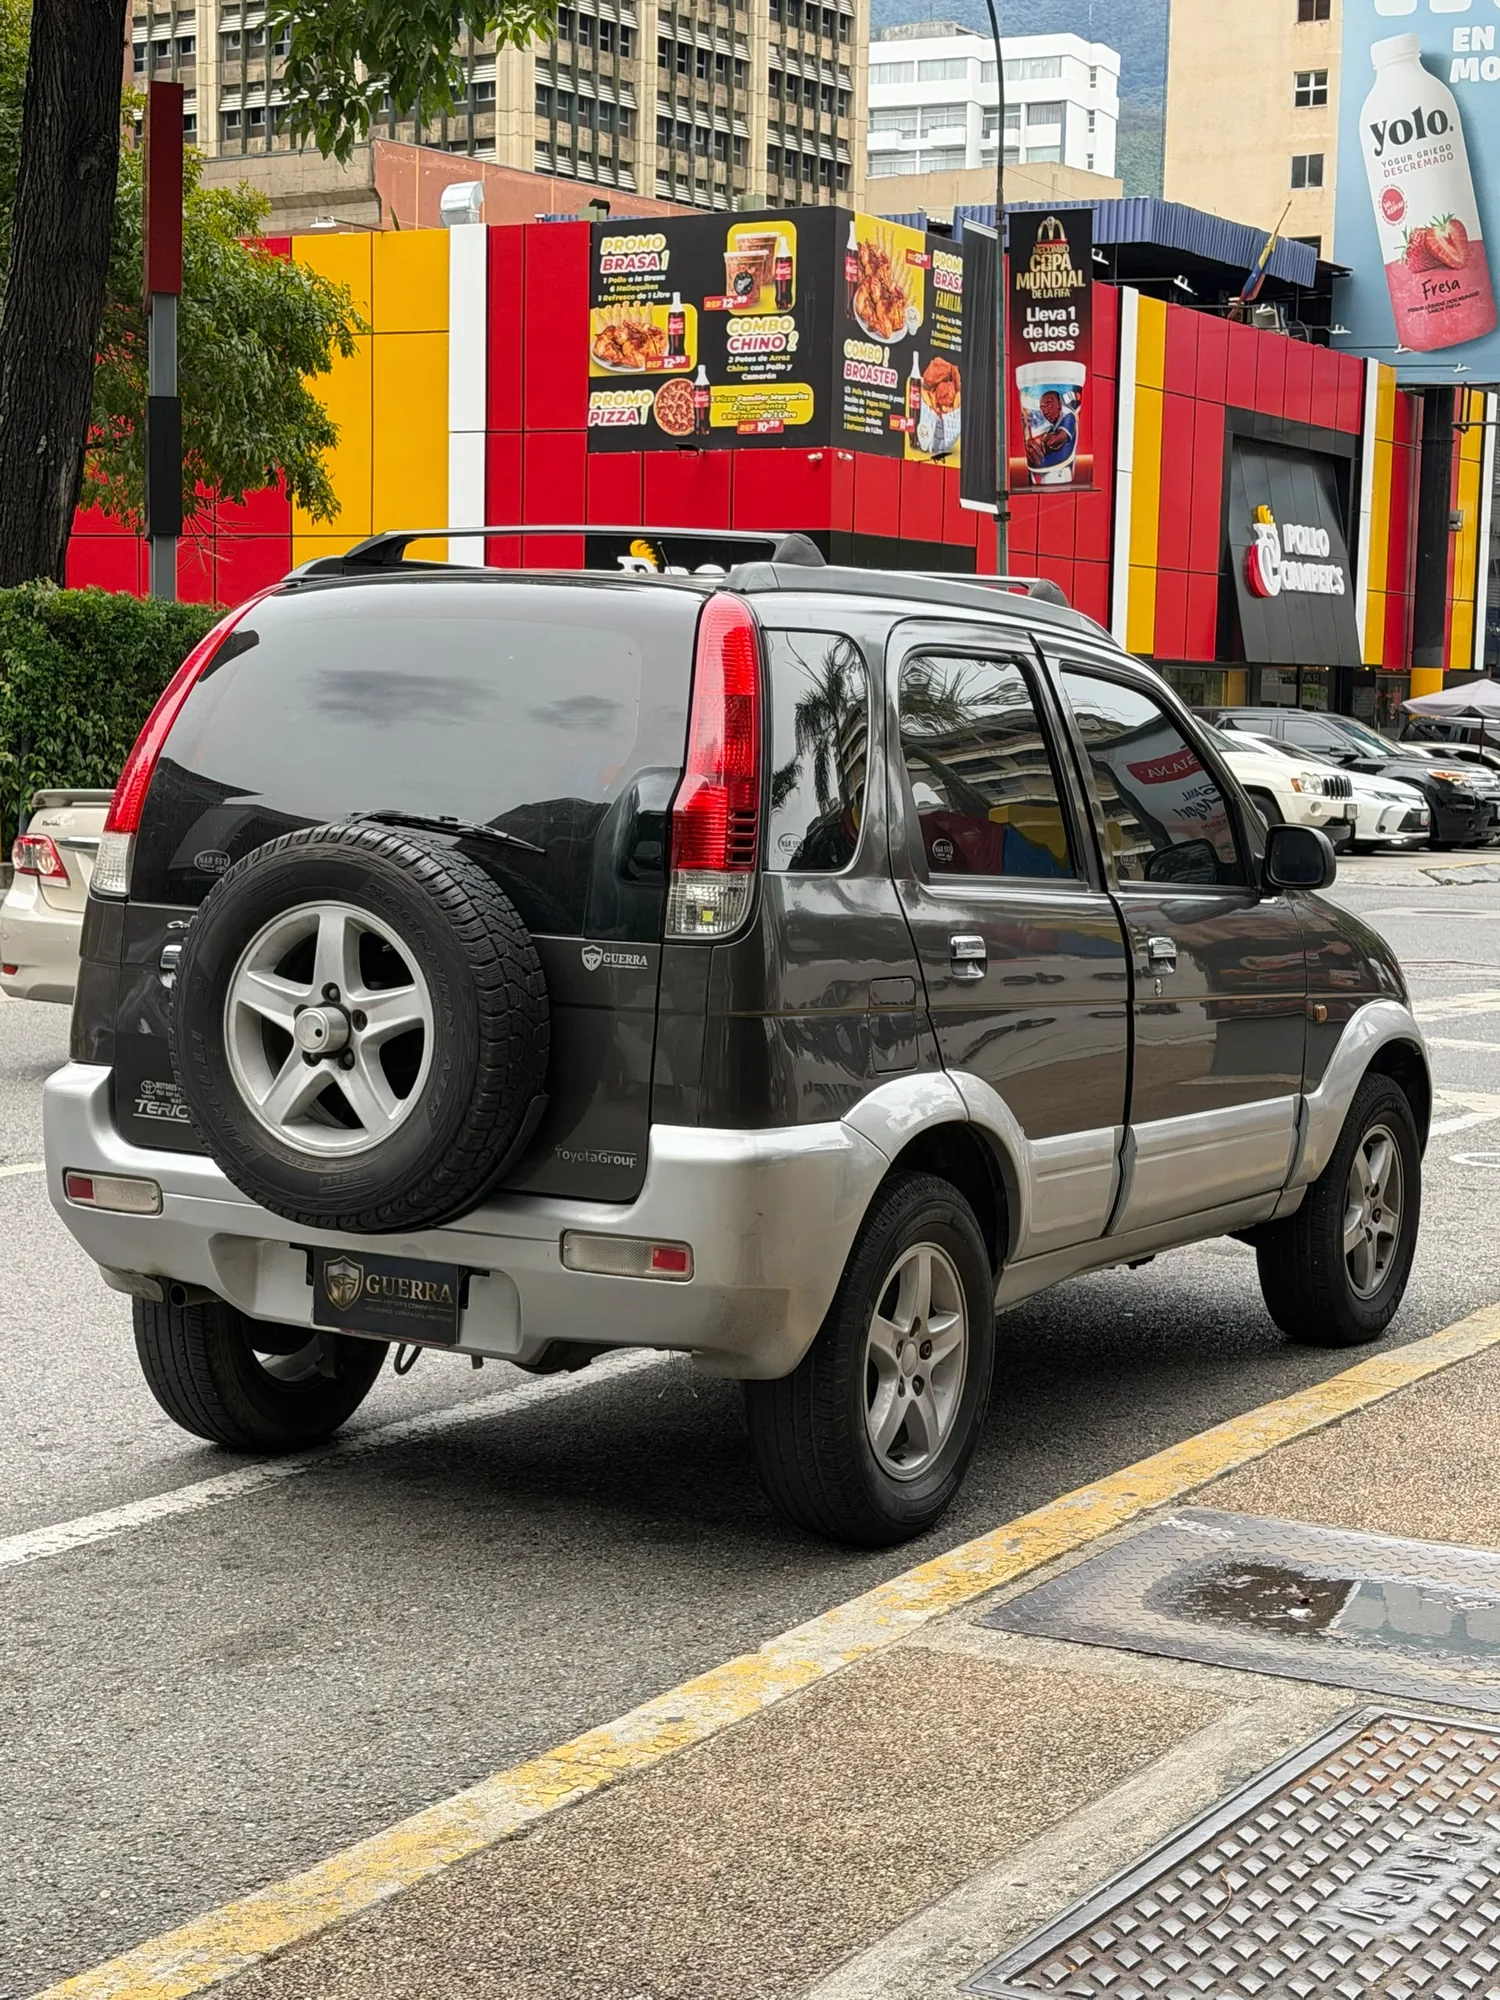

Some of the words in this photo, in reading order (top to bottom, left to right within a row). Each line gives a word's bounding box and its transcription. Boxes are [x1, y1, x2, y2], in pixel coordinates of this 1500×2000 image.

[1452, 25, 1495, 52] EN
[1381, 154, 1413, 168] YOGUR
[1416, 143, 1452, 159] GRIEGO
[1383, 152, 1454, 178] DESCREMADO
[600, 234, 666, 255] PROMO
[600, 253, 661, 274] BRASA
[661, 250, 670, 271] 1
[932, 250, 963, 275] PROM
[1029, 254, 1072, 272] COPA
[1016, 270, 1086, 290] MUNDIAL
[1421, 278, 1461, 301] Fresa
[603, 294, 635, 302] Refresco
[653, 291, 671, 299] Litro
[935, 290, 962, 313] FAMILIA
[1032, 290, 1042, 299] DE
[1043, 289, 1053, 298] LA
[1026, 306, 1067, 322] Lleva
[1068, 306, 1076, 320] 1
[726, 315, 795, 336] COMBO
[1023, 324, 1043, 339] de
[1044, 323, 1068, 338] los
[1069, 322, 1080, 337] 6
[727, 334, 786, 354] CHINO
[786, 331, 799, 352] 2
[843, 338, 883, 364] COMBO
[1029, 339, 1076, 353] vasos
[843, 360, 898, 389] BROASTER
[589, 390, 654, 409] PROMO
[588, 408, 640, 427] PIZZA
[640, 405, 650, 425] 1
[1282, 523, 1330, 558] POLLO
[603, 952, 648, 966] GUERRA
[134, 1099, 188, 1118] TERIO
[554, 1147, 637, 1169] ToyotaGroup
[365, 1274, 454, 1304] GUERRA
